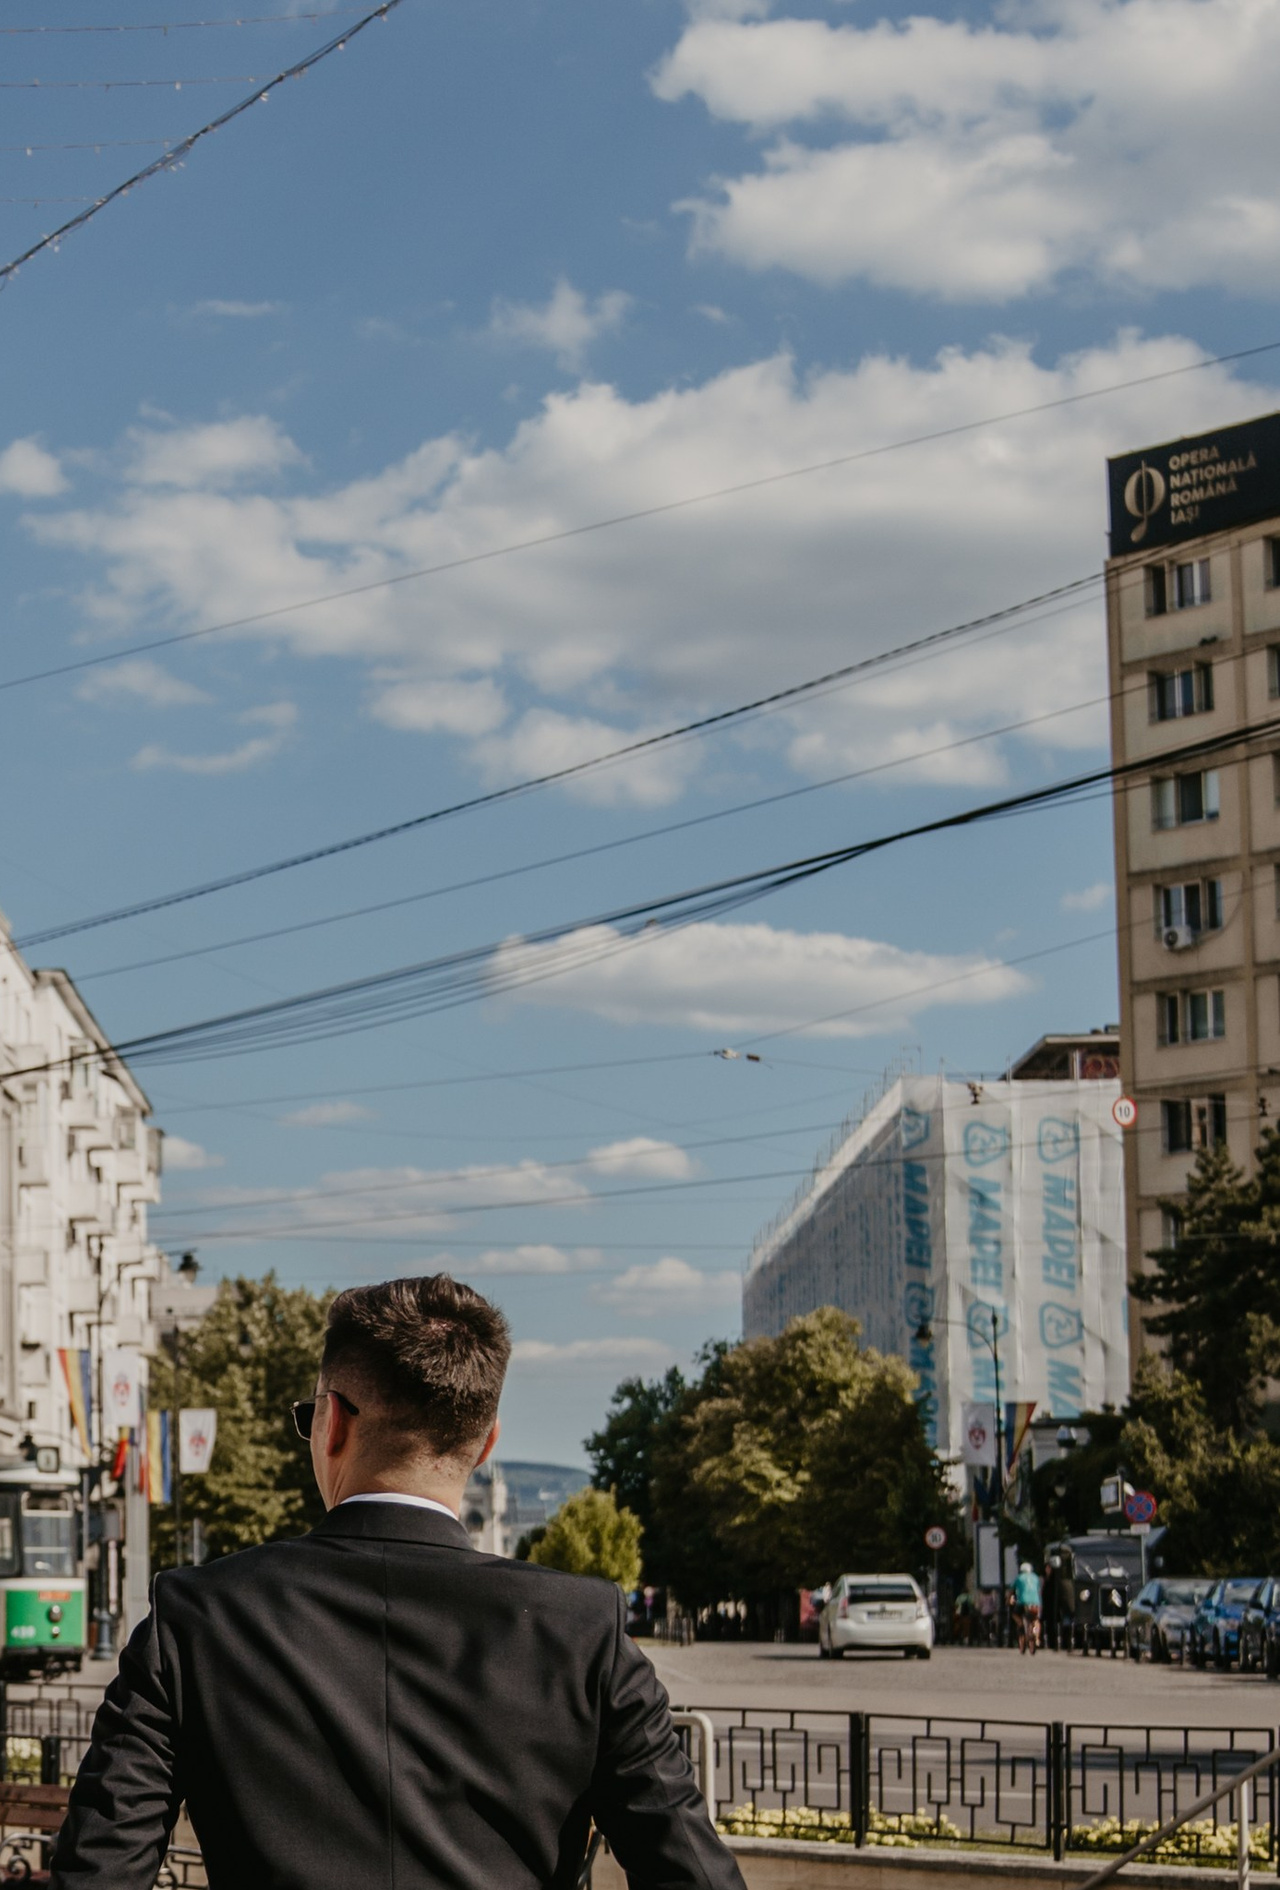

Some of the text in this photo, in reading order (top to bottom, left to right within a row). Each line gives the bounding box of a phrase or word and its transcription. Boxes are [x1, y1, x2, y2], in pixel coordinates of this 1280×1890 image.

[1169, 445, 1220, 471] OPERA
[1119, 1105, 1131, 1117] 10
[903, 1162, 932, 1269] MAPEI
[967, 1175, 1003, 1296] MAPEI
[1042, 1173, 1076, 1292] MAPEI
